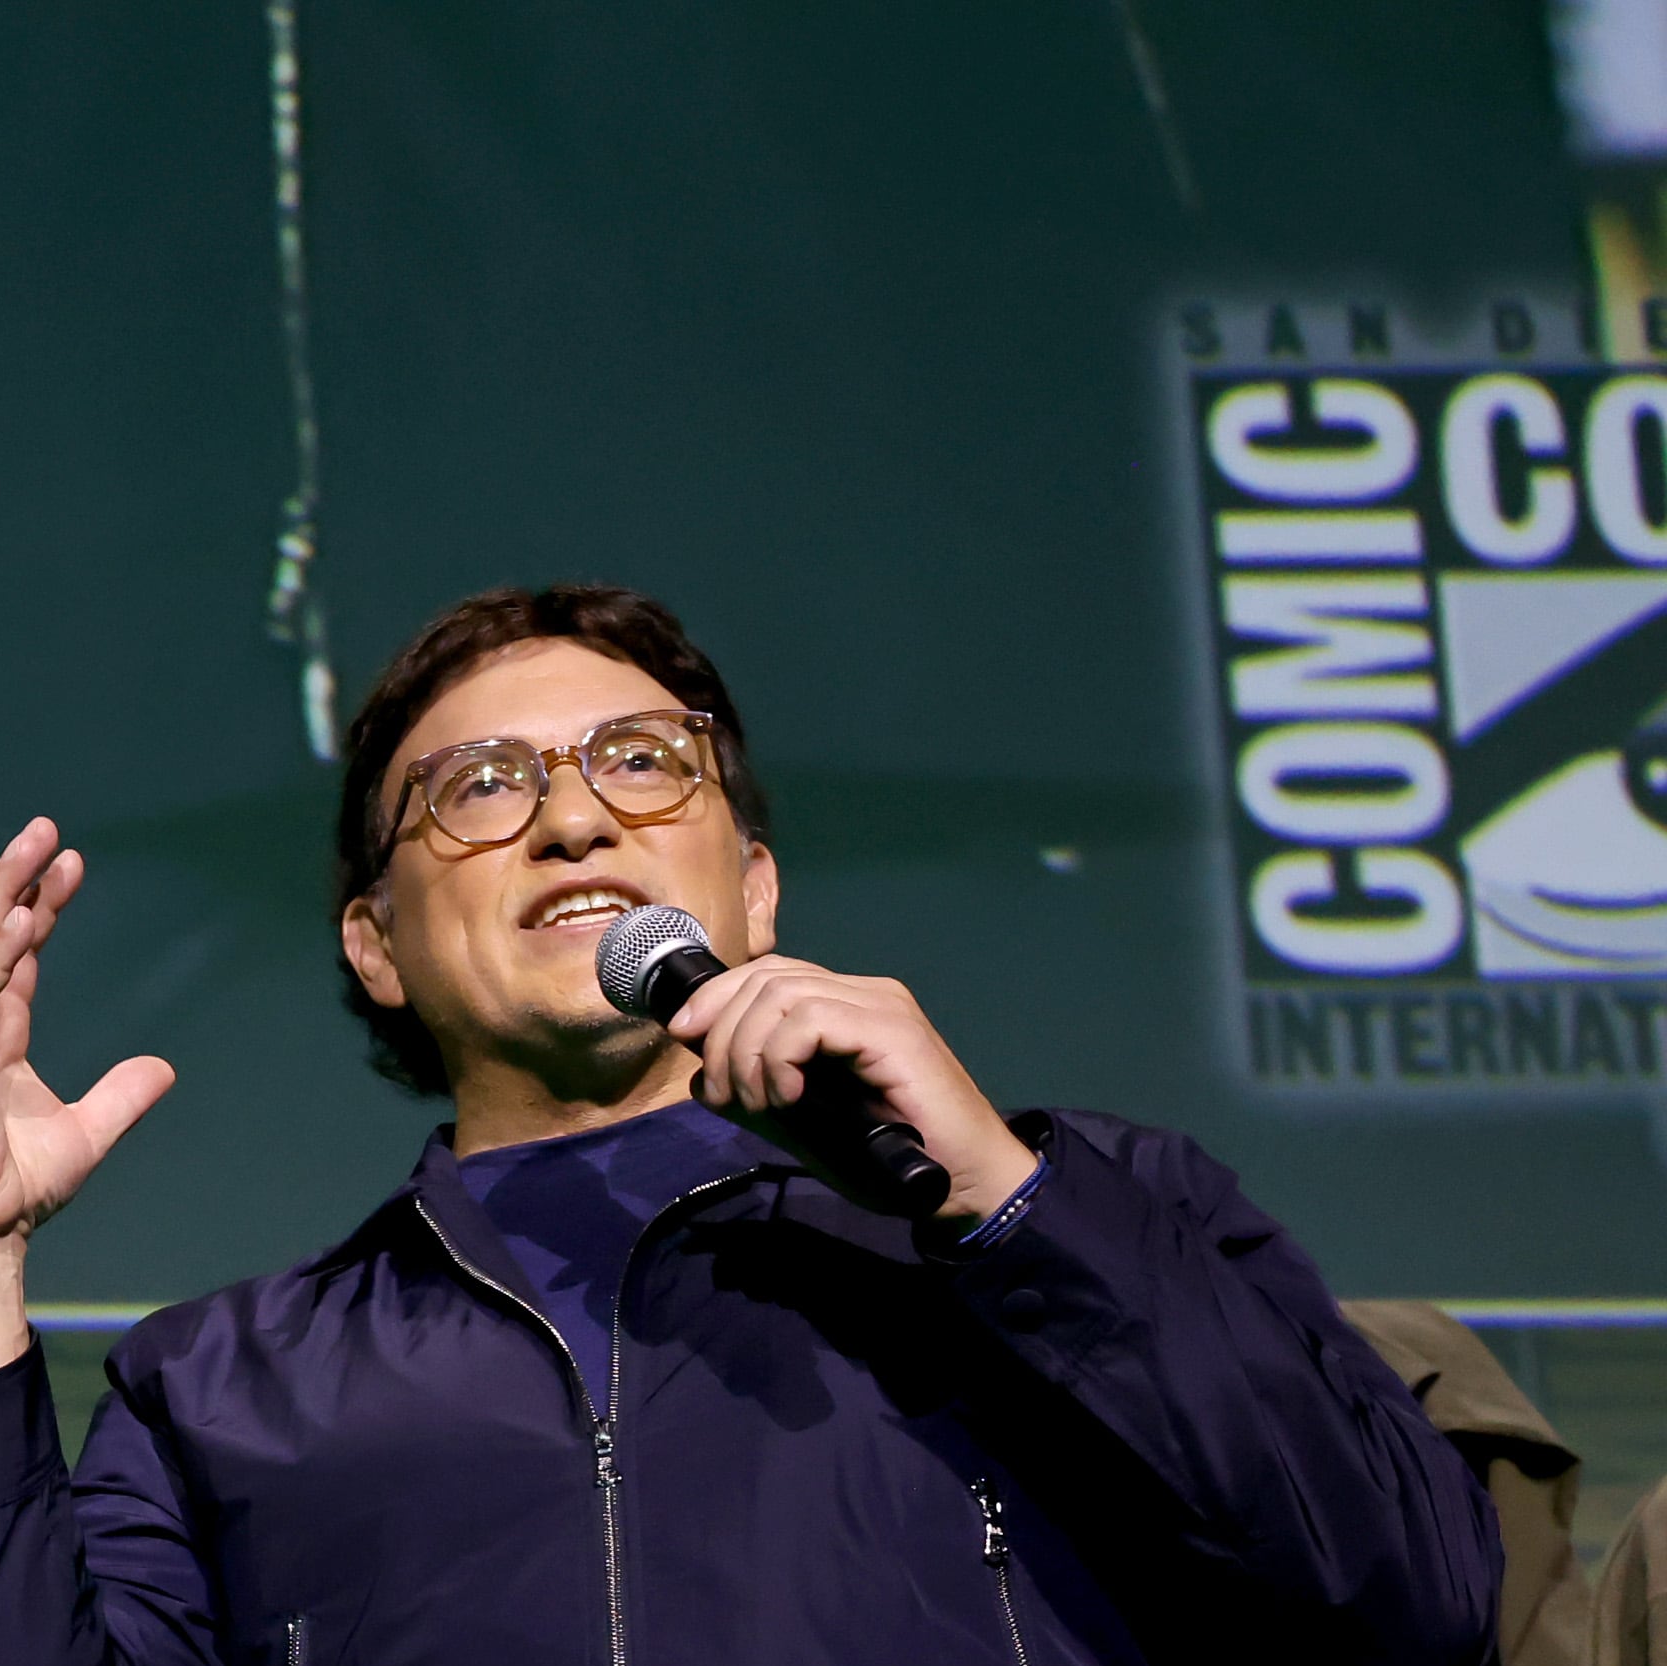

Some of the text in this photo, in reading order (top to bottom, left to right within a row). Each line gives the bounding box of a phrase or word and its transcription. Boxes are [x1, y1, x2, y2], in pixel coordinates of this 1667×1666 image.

[1180, 302, 1391, 359] SAN
[1439, 372, 1667, 569] CO
[1207, 375, 1464, 978] COMIC
